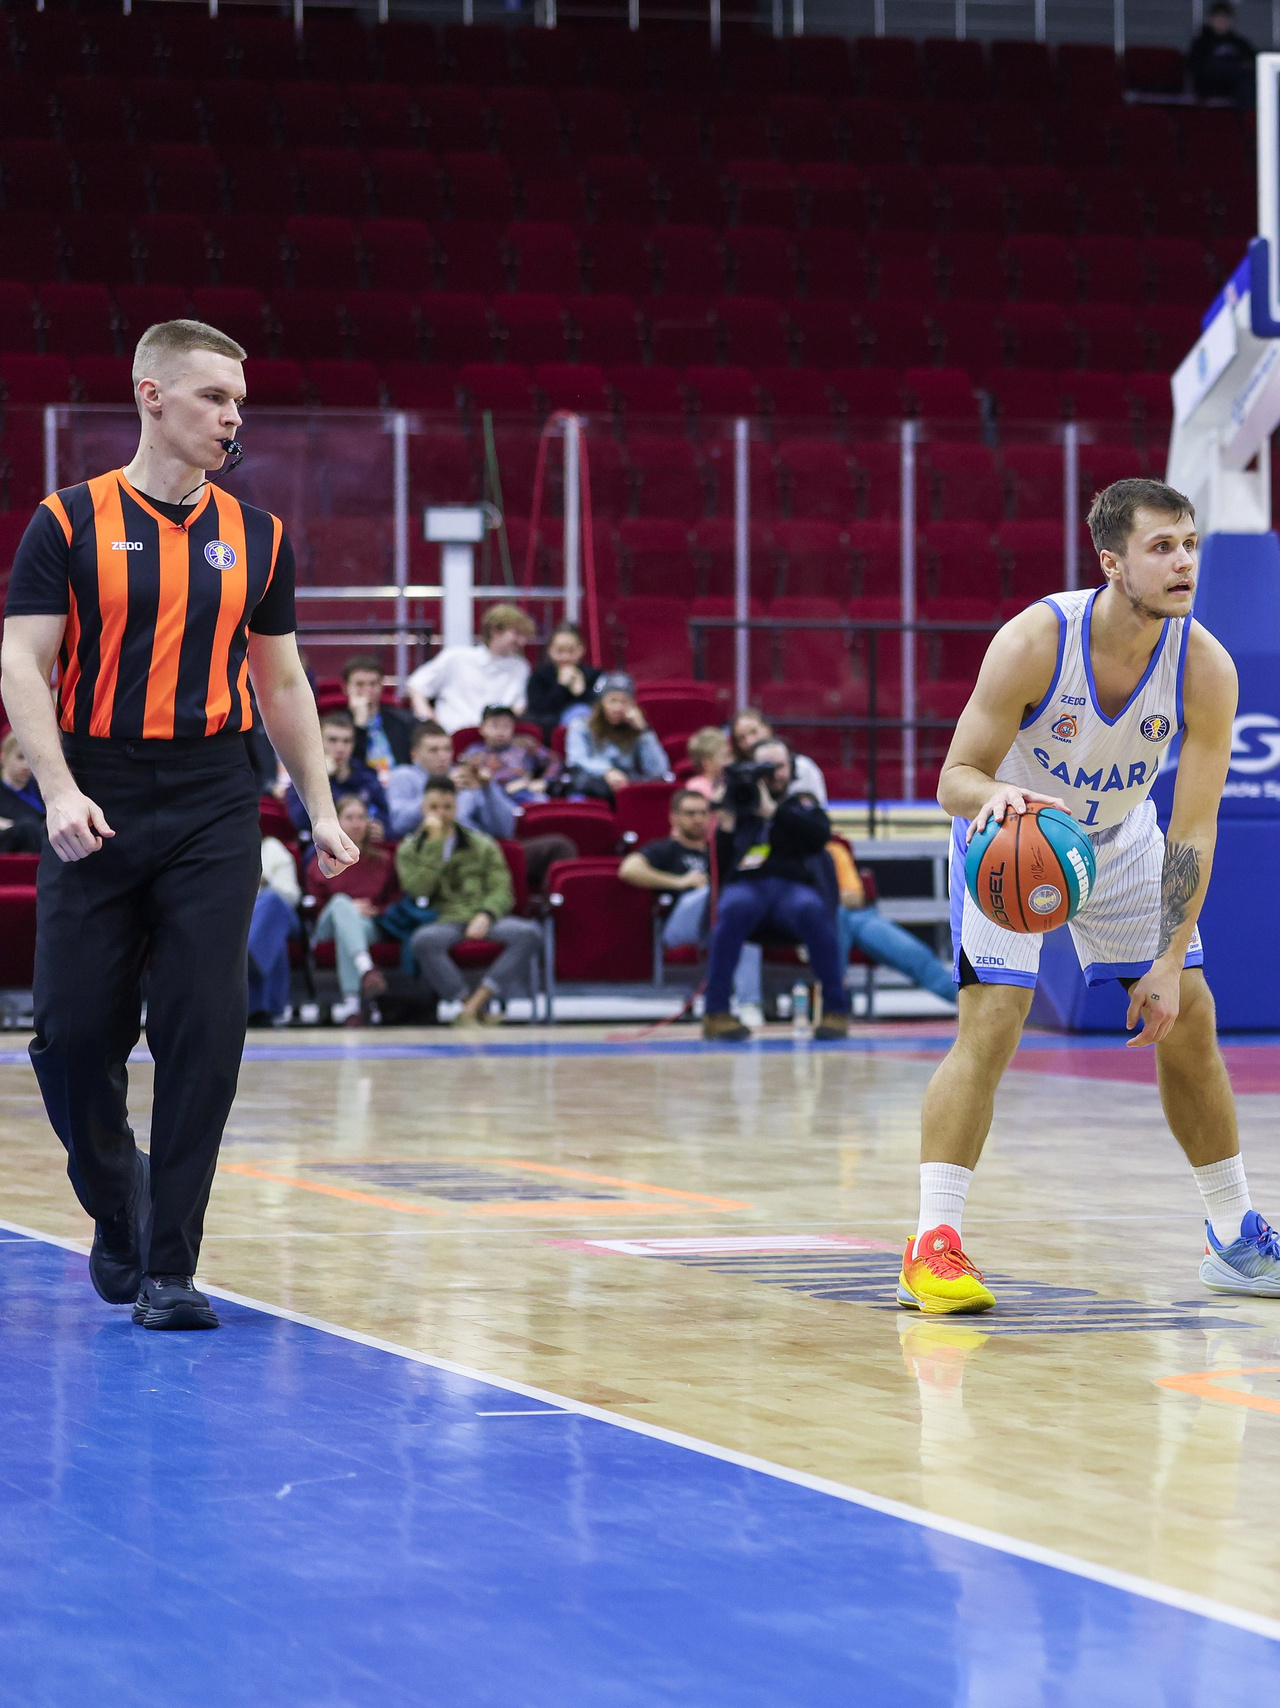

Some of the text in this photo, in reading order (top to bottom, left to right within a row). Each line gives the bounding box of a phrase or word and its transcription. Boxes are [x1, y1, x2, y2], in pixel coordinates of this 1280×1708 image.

[111, 542, 143, 551] ZEDO
[1061, 695, 1086, 706] ZEDO
[1078, 800, 1100, 826] 1
[975, 955, 1005, 966] ZEDO
